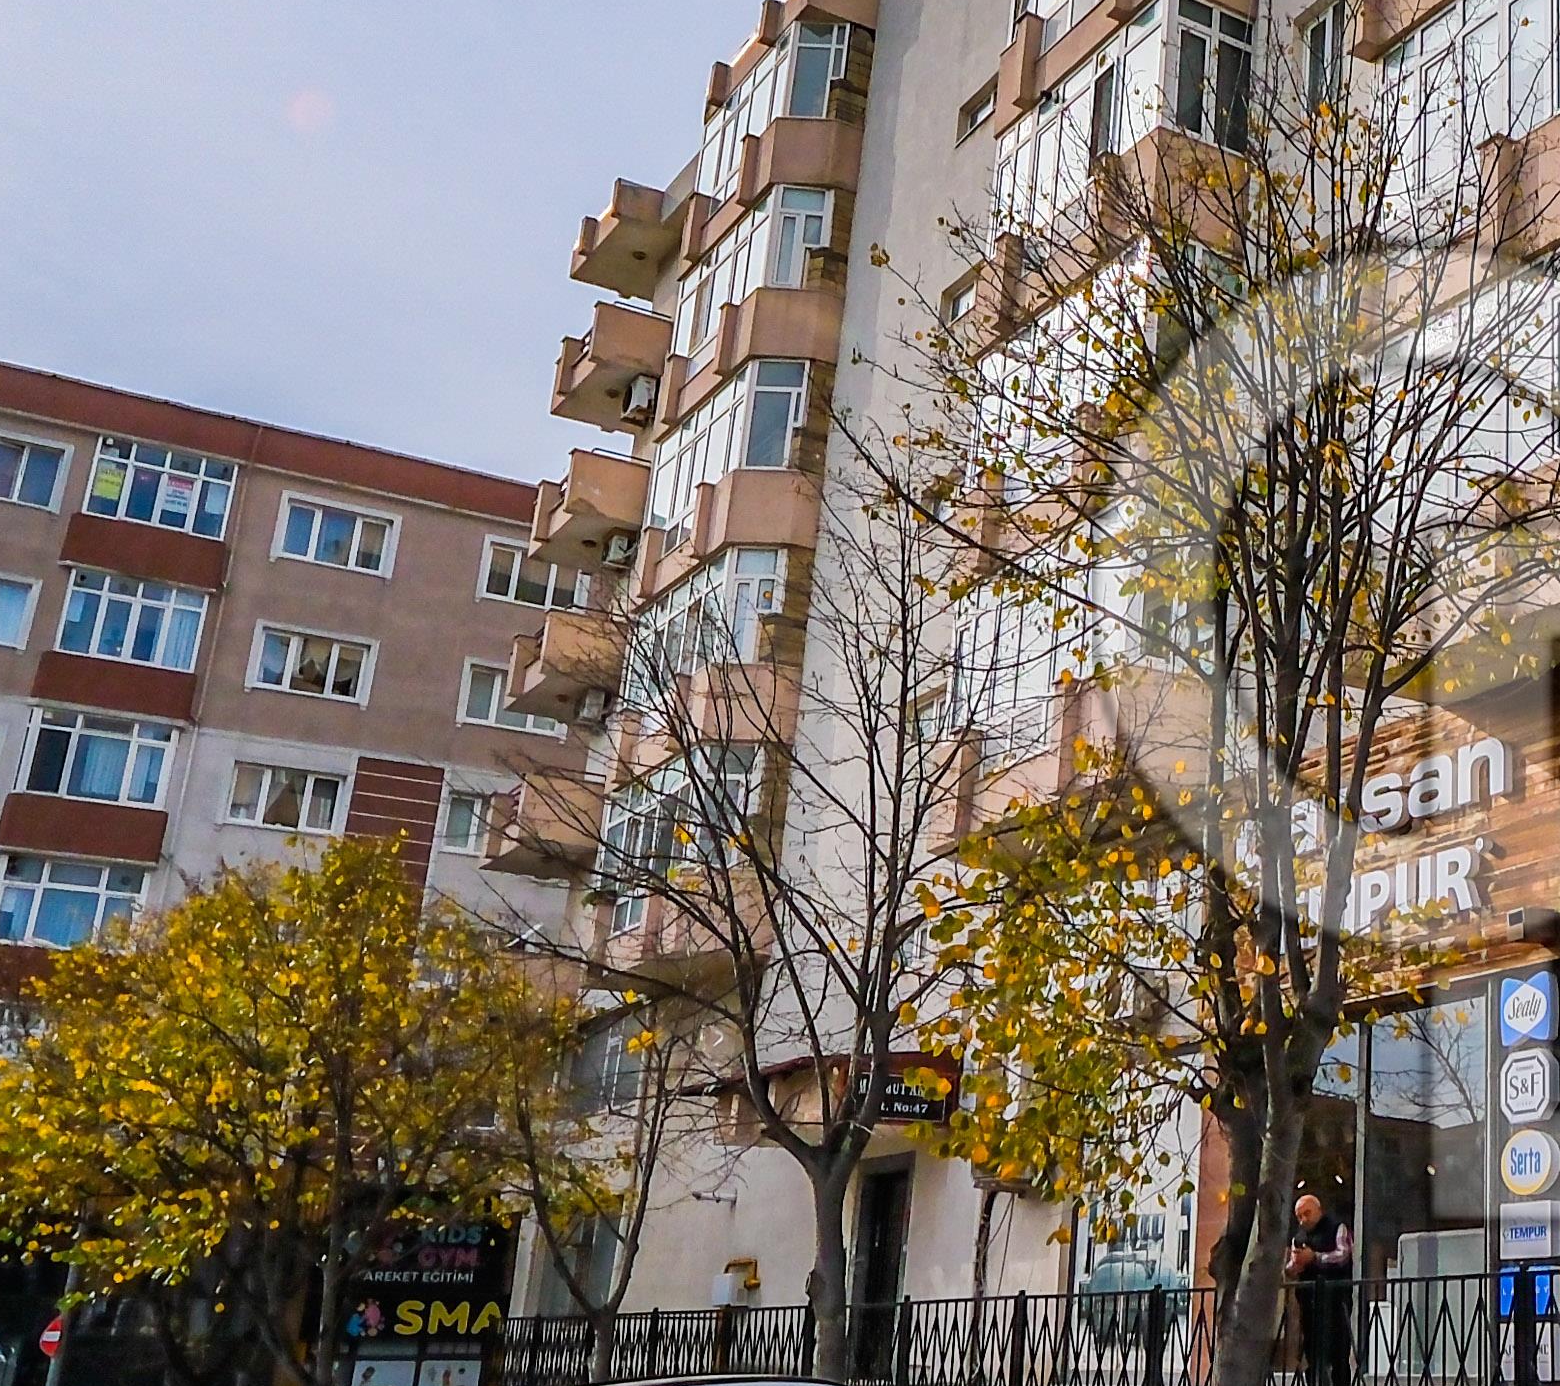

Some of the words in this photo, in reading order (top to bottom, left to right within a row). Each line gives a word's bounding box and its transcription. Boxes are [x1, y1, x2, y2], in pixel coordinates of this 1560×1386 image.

[1508, 992, 1542, 1021] Sealy
[1509, 1072, 1541, 1100] S&F
[893, 1102, 929, 1114] No:47
[1510, 1147, 1541, 1175] Serta
[1509, 1226, 1547, 1240] TEMPUR
[361, 1270, 419, 1283] AREKET
